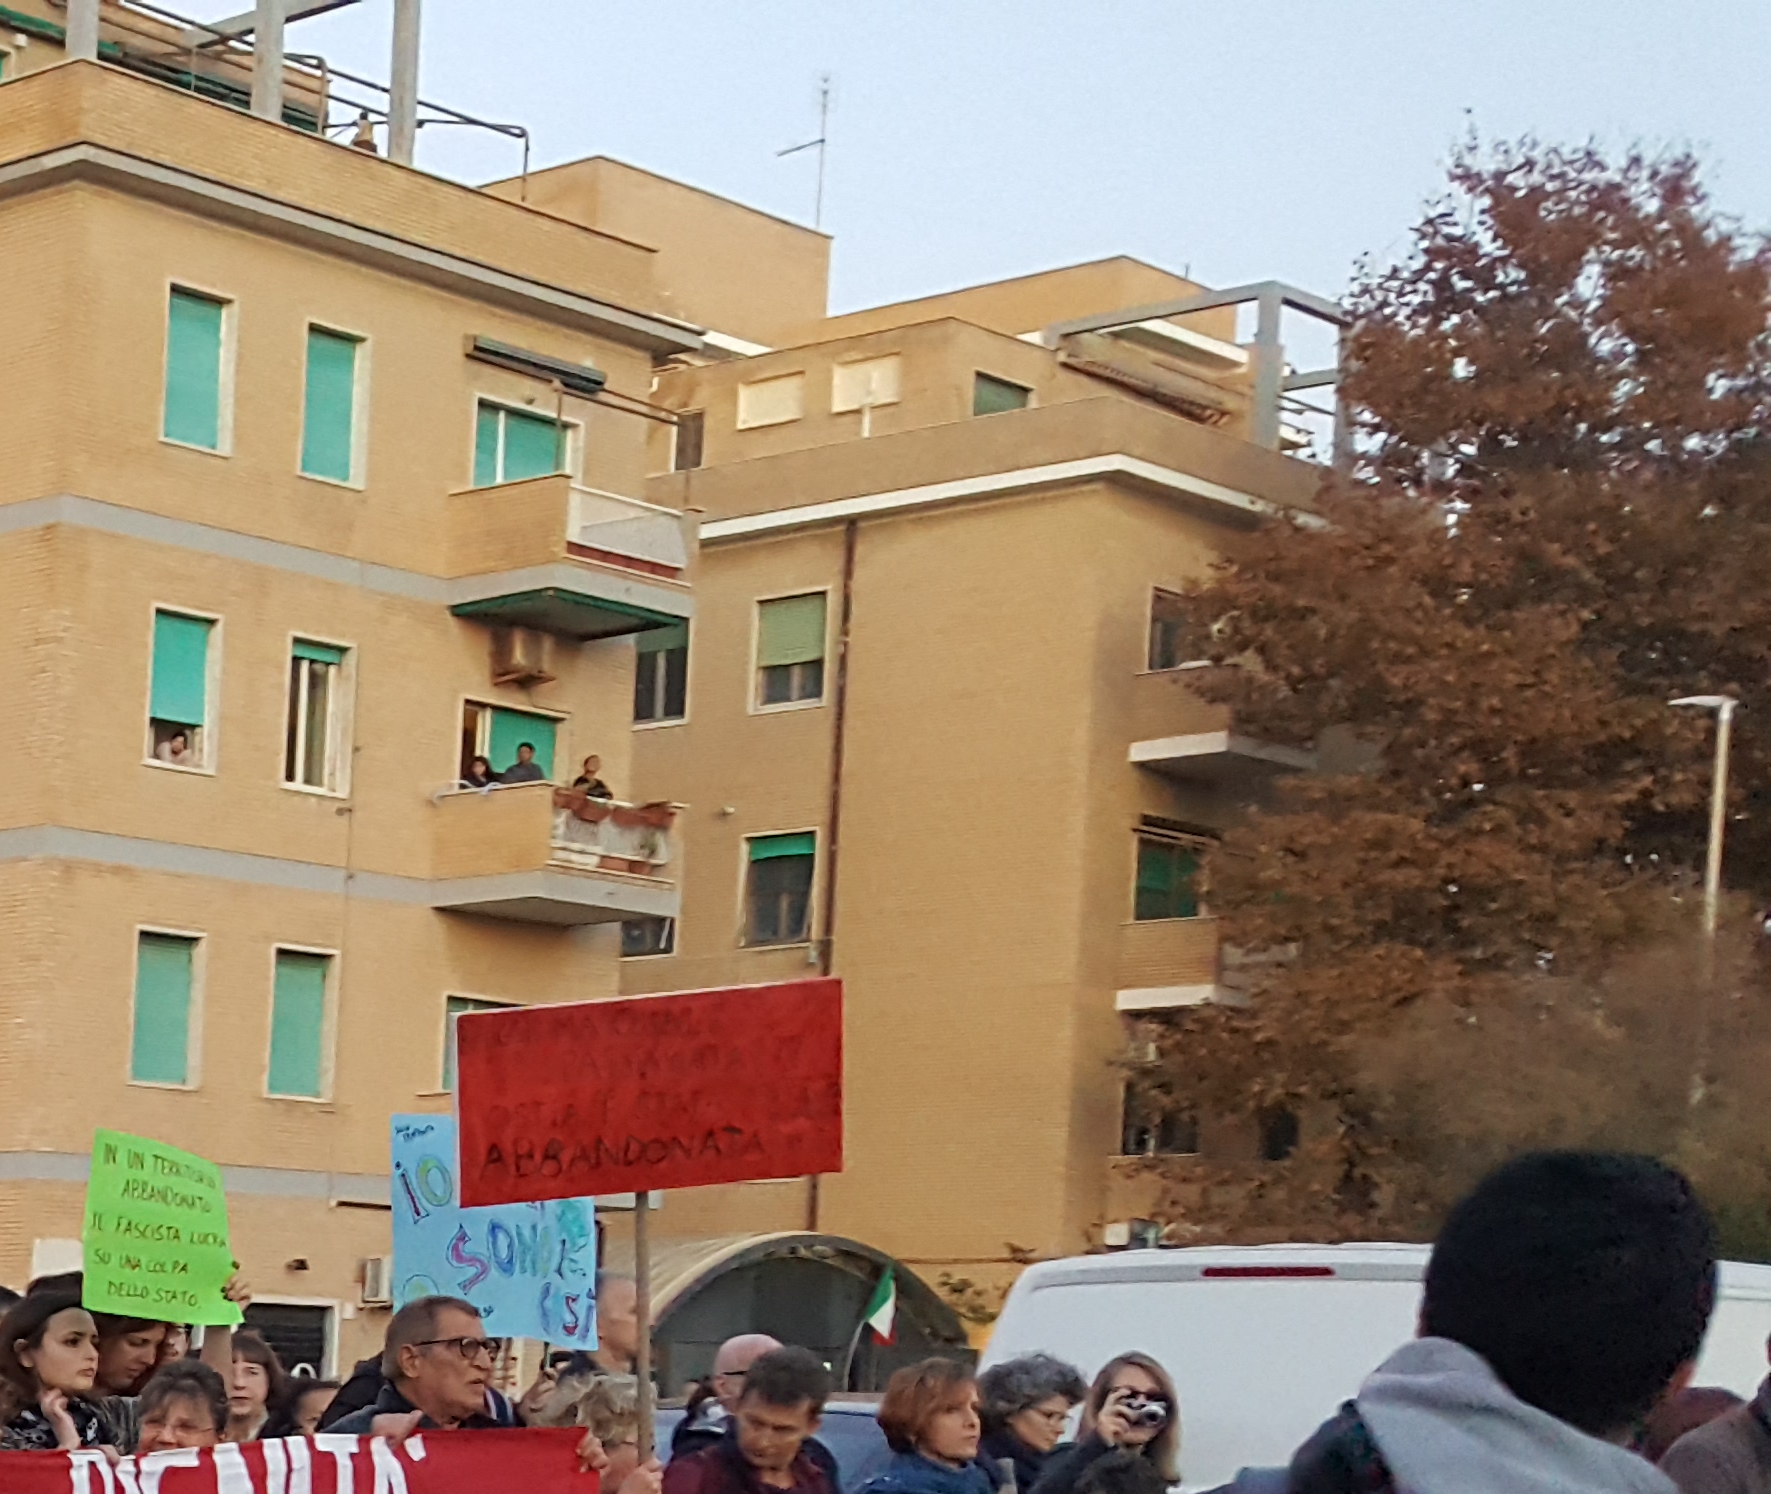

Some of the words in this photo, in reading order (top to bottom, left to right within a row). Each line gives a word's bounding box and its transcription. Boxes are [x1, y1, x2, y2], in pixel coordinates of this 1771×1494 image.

[103, 1142, 118, 1165] IN
[127, 1148, 145, 1170] UN
[480, 1125, 766, 1181] ABBANDONATA
[115, 1216, 182, 1243] FASCISTA
[92, 1248, 112, 1266] SU
[119, 1253, 142, 1271] UNA
[107, 1280, 150, 1299] DELLO
